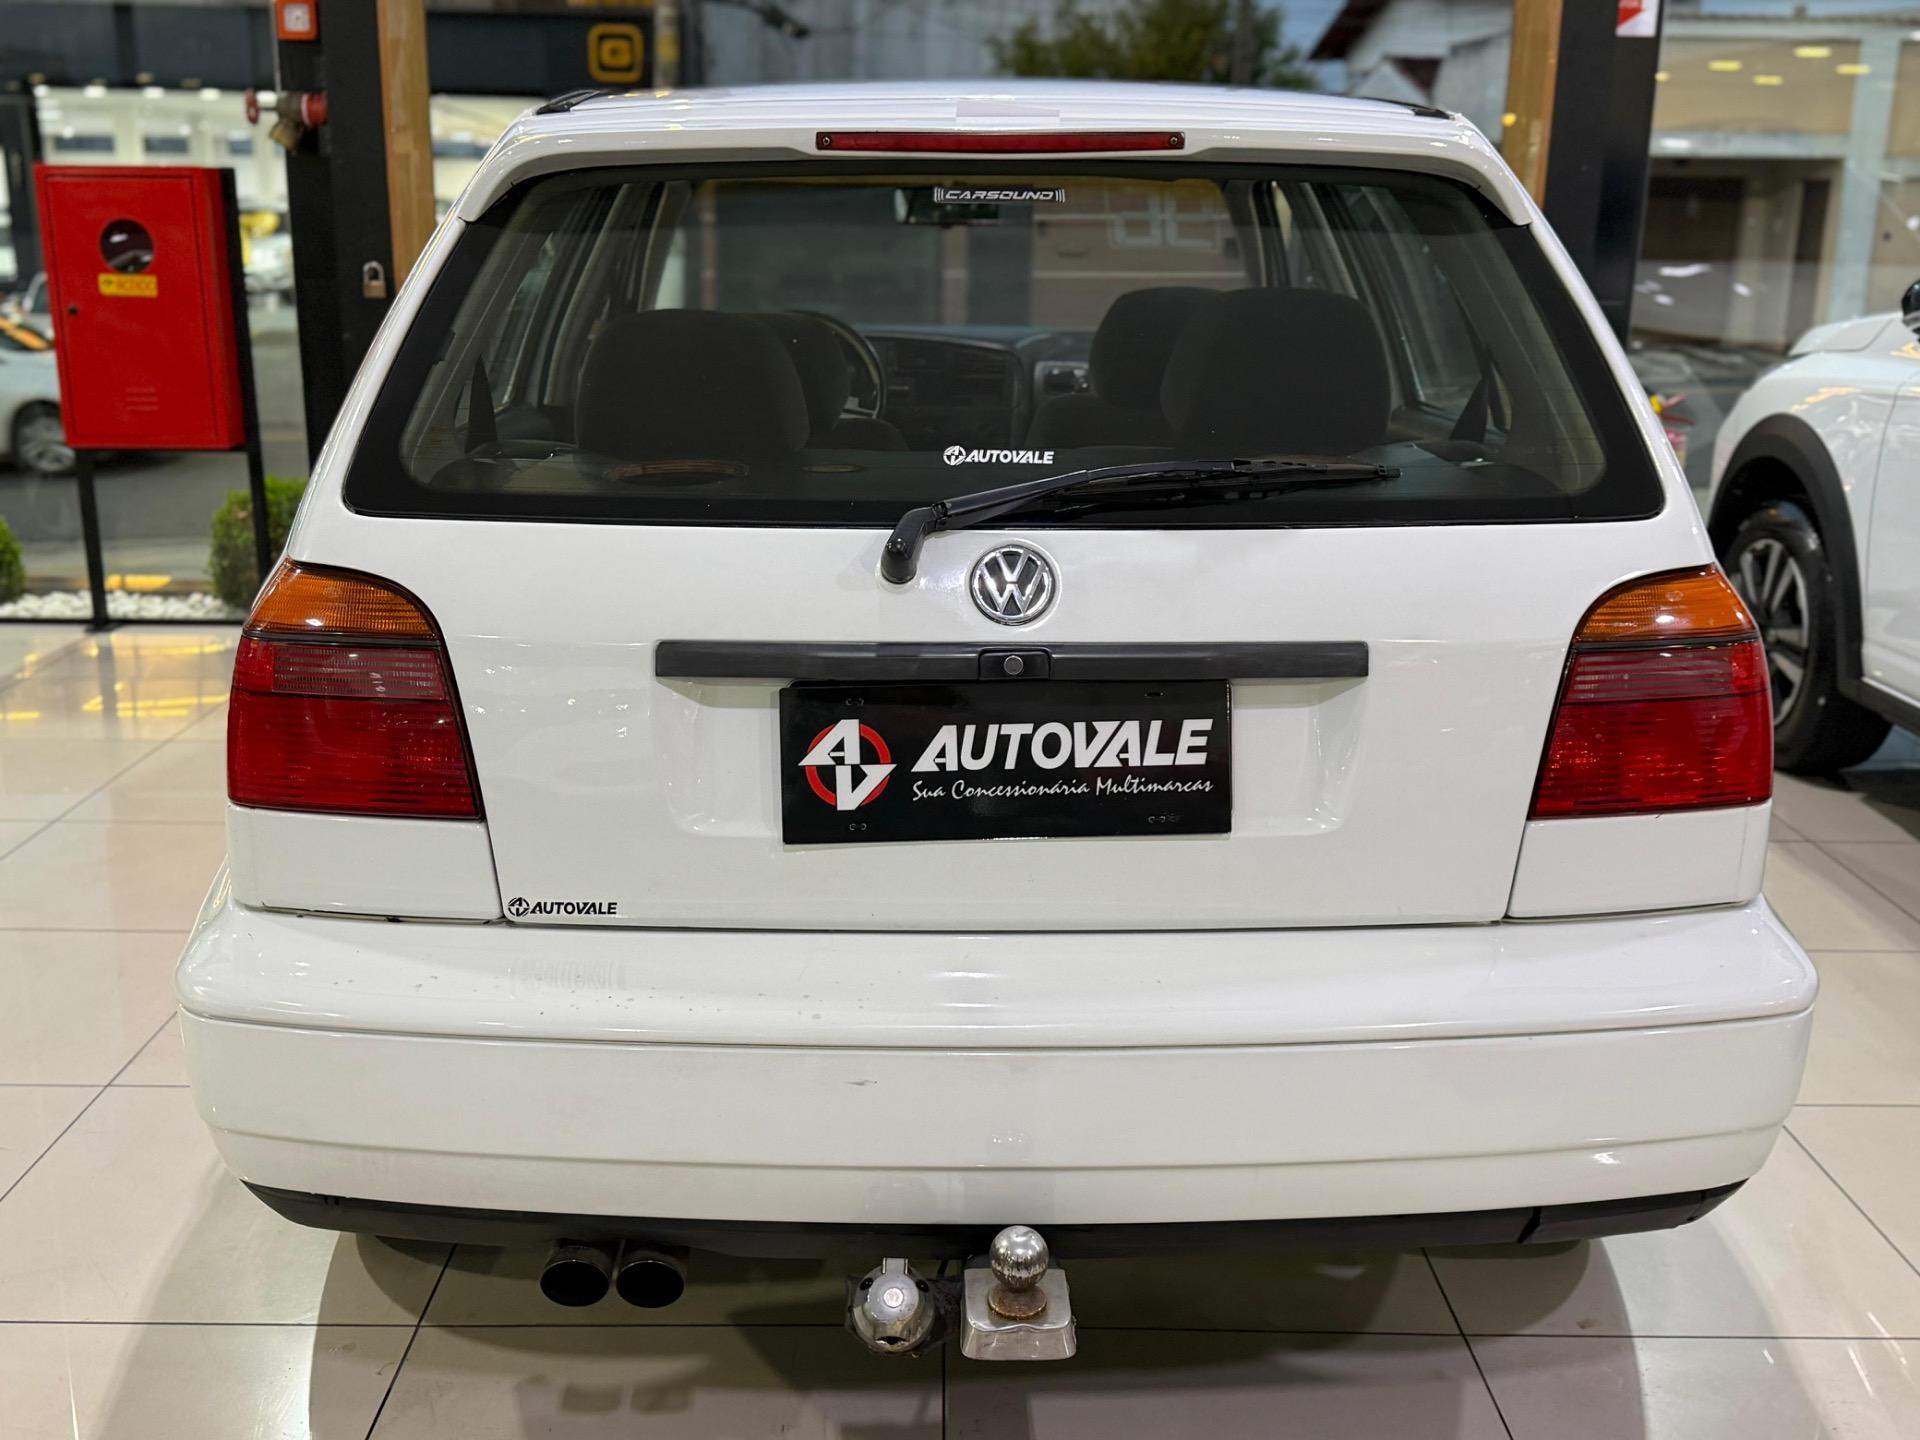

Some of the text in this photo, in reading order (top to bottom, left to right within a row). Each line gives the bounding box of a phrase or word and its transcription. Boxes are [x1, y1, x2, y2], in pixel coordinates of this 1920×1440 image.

[945, 190, 1054, 200] CARSOUND
[965, 449, 1055, 465] AUTOVALE
[911, 718, 1213, 772] AUTOVALE
[912, 777, 1214, 802] Sua Concessionária Multimarcas
[530, 902, 617, 915] AUTOVALE
